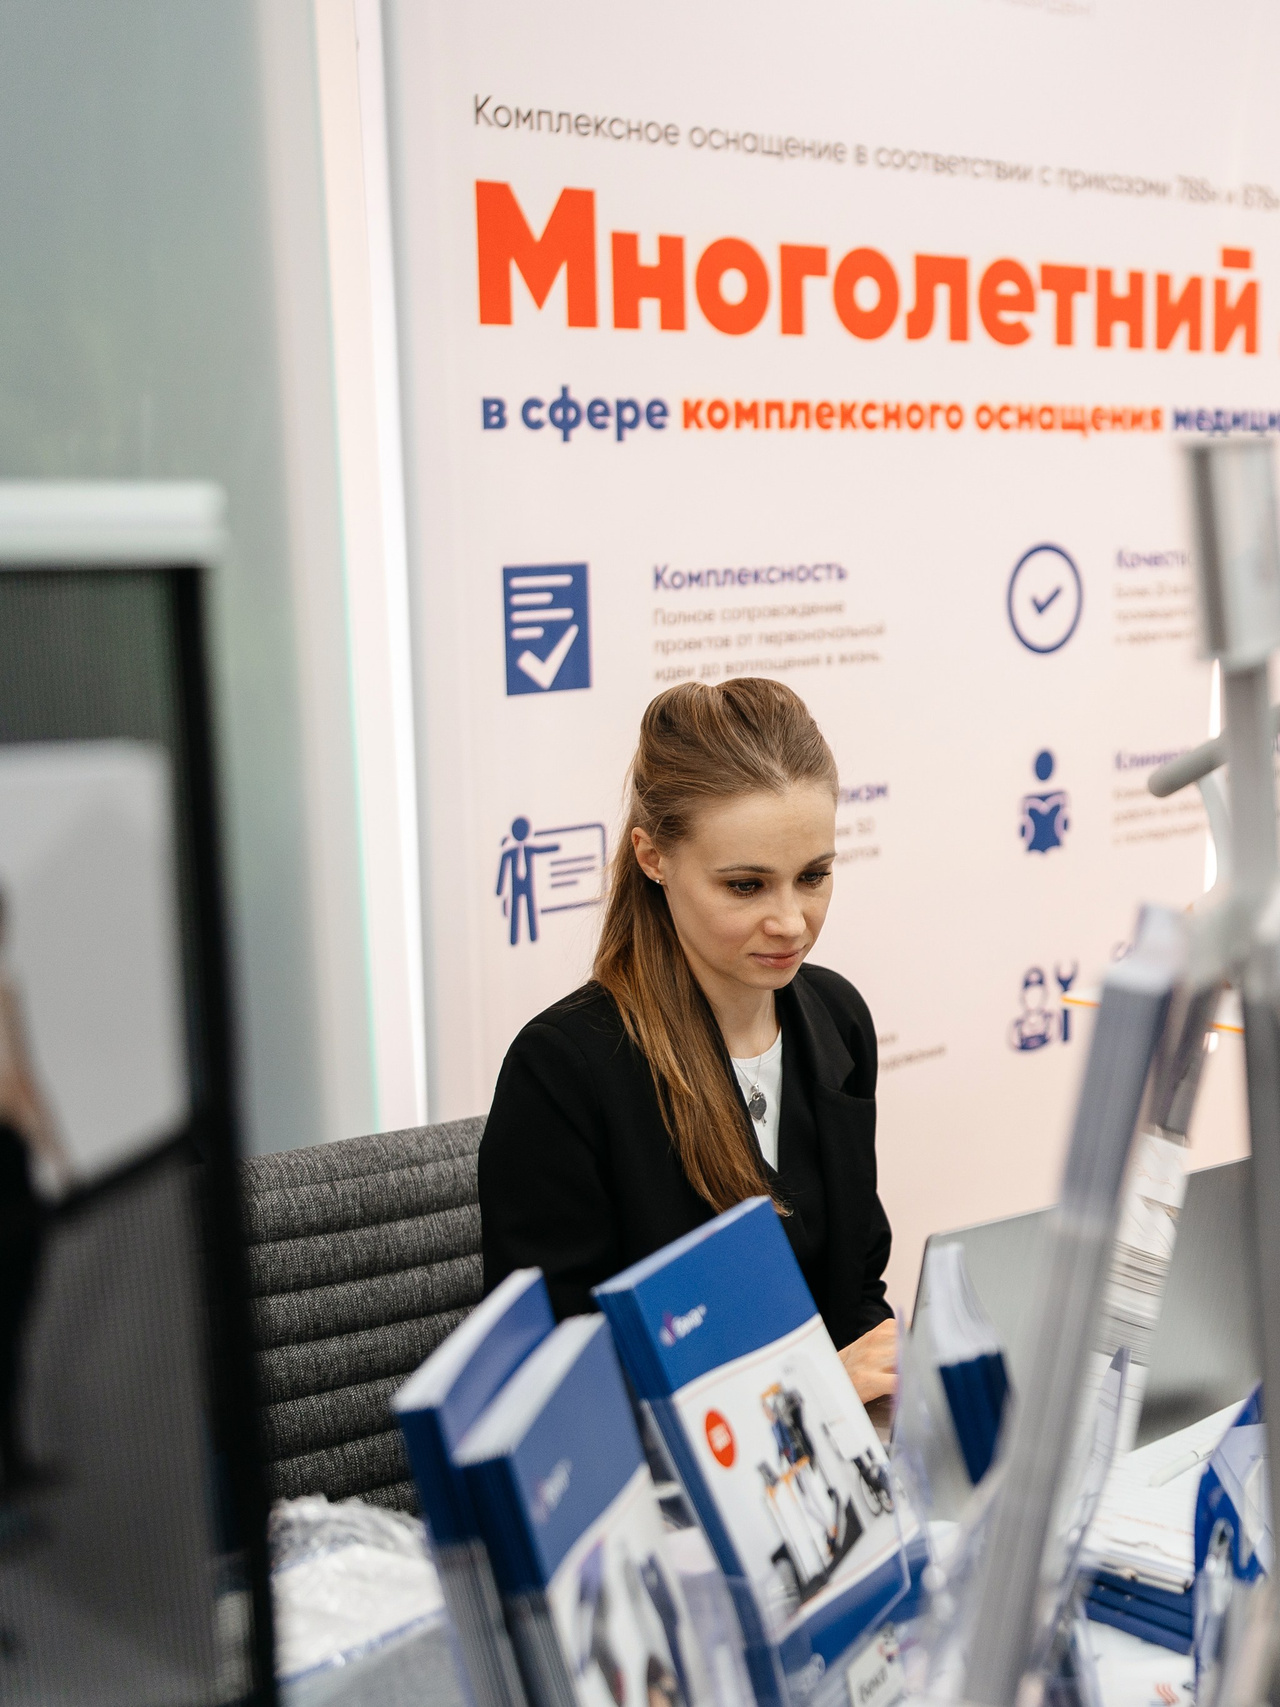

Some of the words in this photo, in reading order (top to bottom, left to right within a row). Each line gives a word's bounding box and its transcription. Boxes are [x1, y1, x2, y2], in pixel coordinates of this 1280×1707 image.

[474, 94, 680, 146] Комплексное
[689, 123, 848, 163] оснащение
[854, 143, 868, 166] в
[873, 147, 1033, 183] соответствии
[1039, 165, 1053, 187] с
[475, 178, 1260, 356] Многолетний
[482, 396, 508, 430] в
[521, 385, 670, 443] сфере
[682, 398, 965, 432] комплексного
[974, 403, 1165, 437] оснащения
[652, 562, 849, 591] Комплексность
[654, 607, 717, 626] Полное
[720, 600, 846, 623] сопровождение
